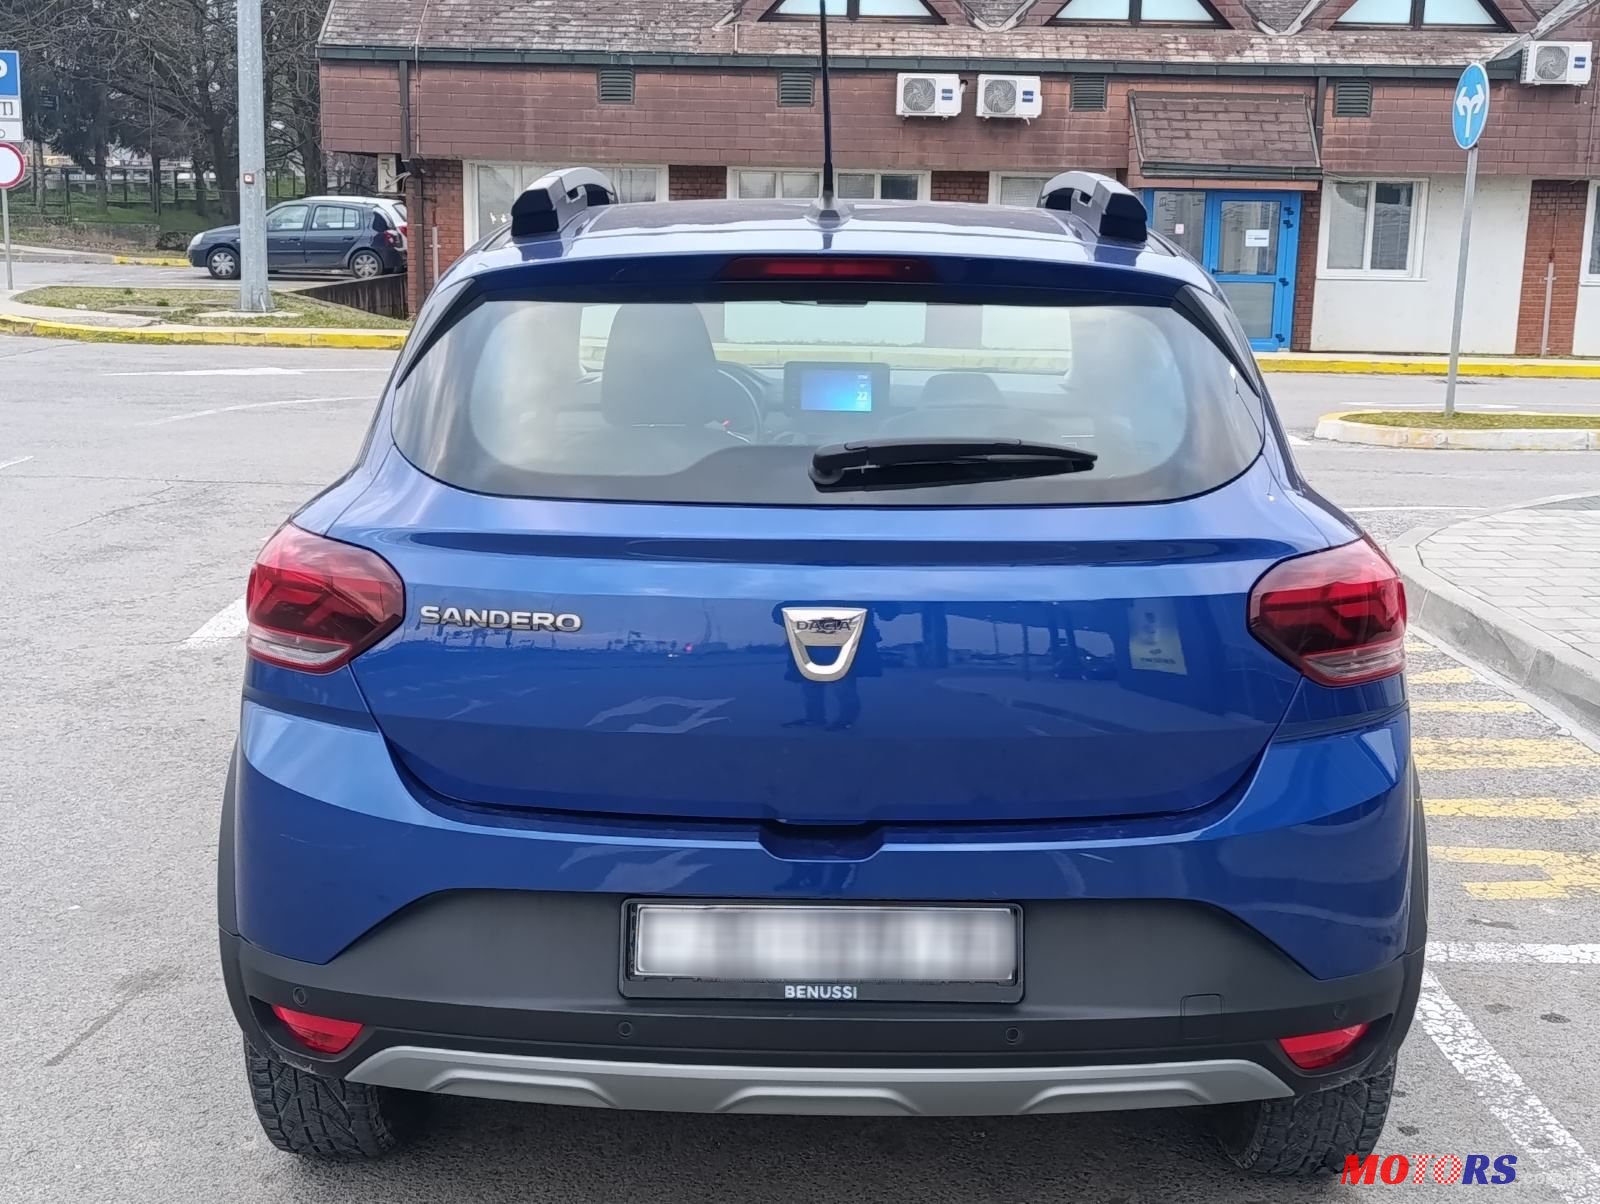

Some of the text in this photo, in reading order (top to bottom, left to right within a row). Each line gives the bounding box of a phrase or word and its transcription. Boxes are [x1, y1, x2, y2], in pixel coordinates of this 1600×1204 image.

[420, 605, 583, 633] SANDERO
[796, 619, 852, 632] DACIA
[784, 984, 858, 999] BENUSSI
